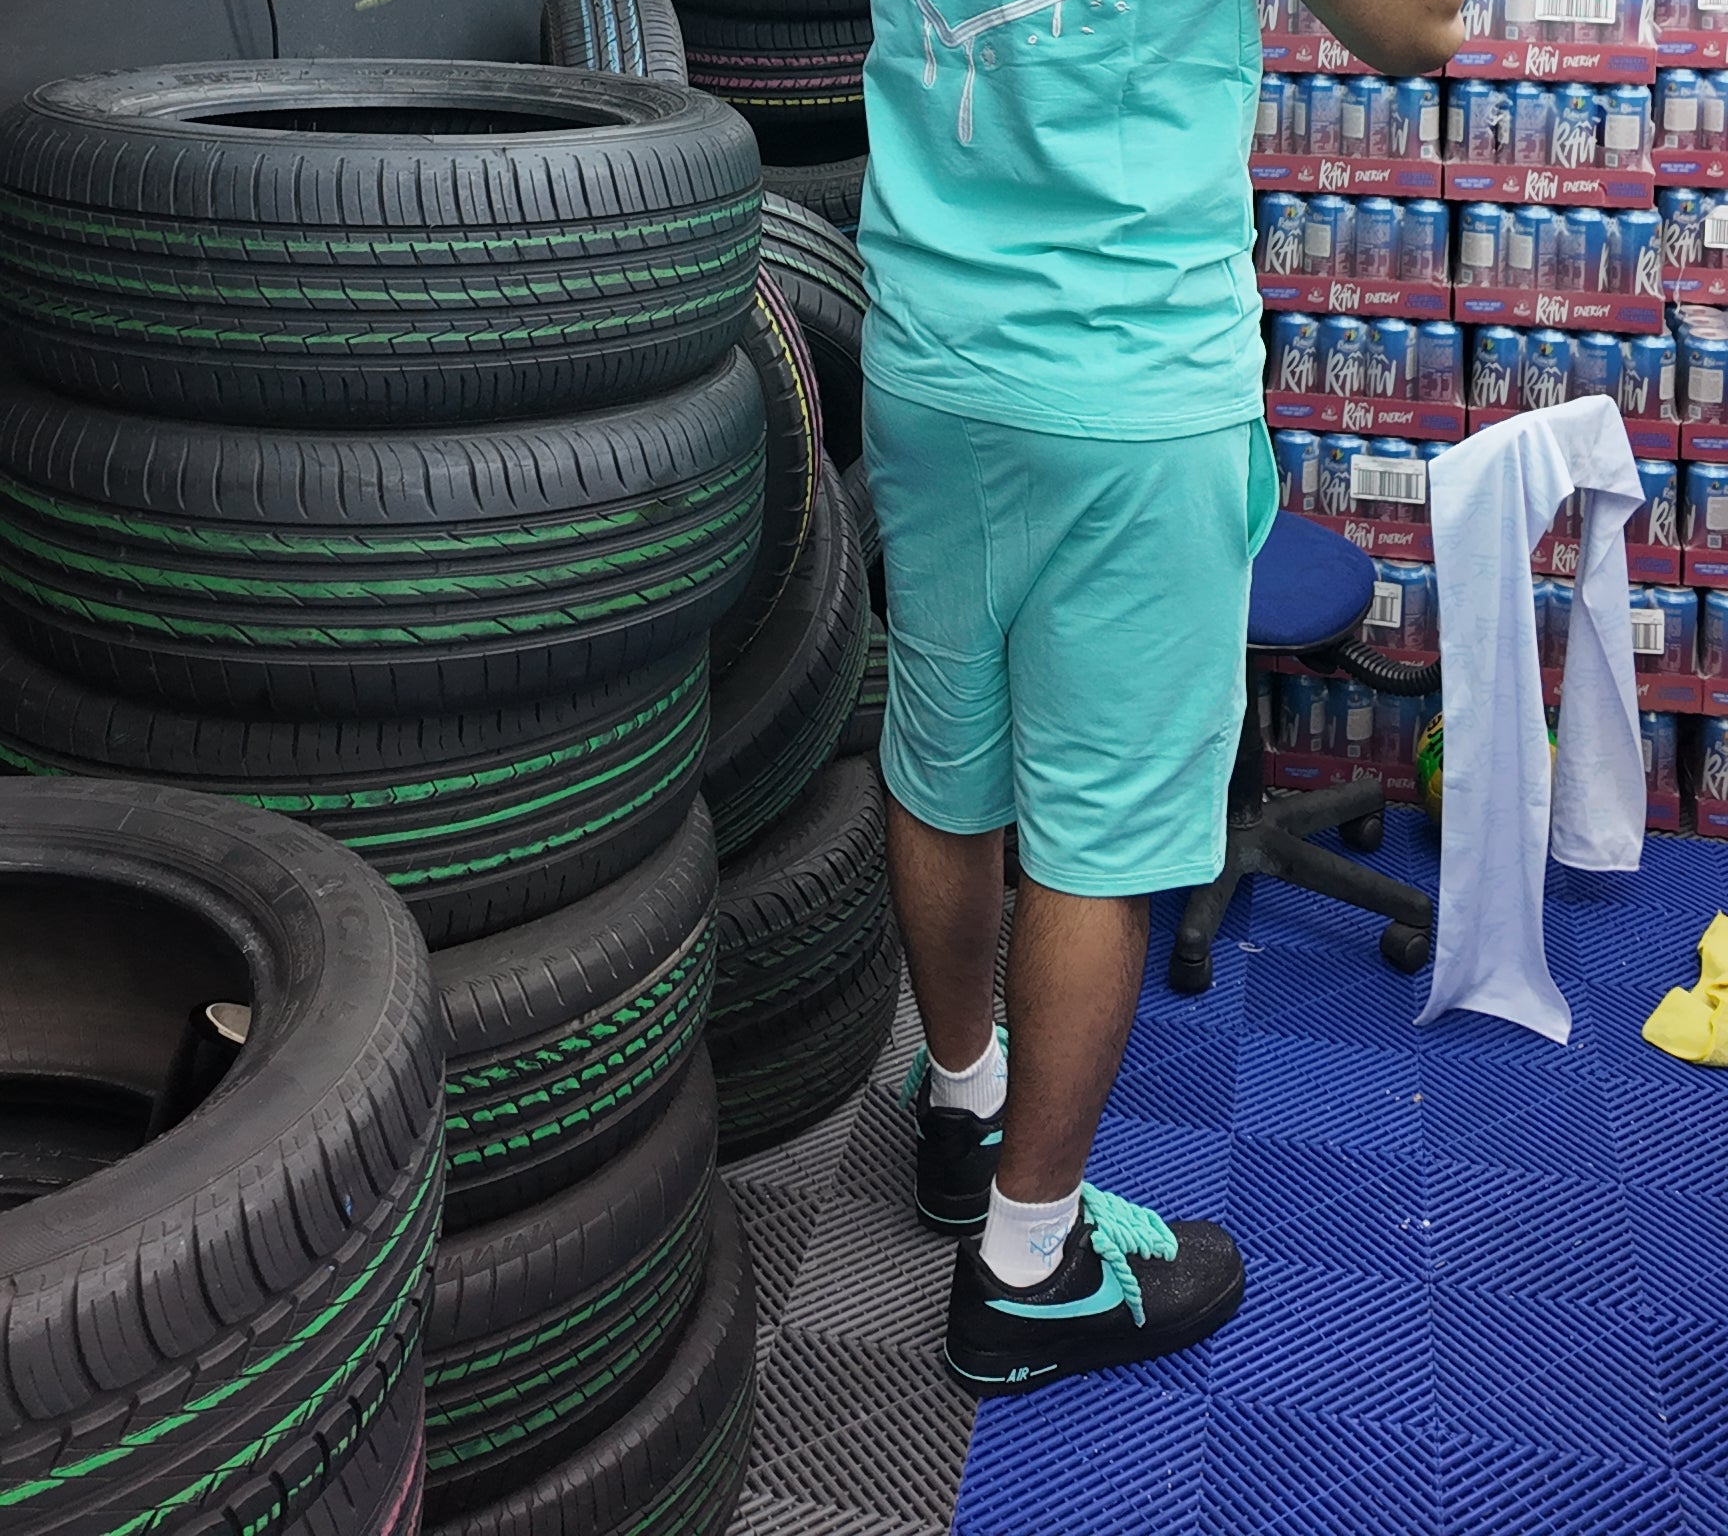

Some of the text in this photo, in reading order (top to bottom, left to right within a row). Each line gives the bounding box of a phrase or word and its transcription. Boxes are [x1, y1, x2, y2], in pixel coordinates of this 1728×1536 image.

[1525, 44, 1560, 77] RAW
[1562, 54, 1601, 69] ENERGY
[1551, 116, 1598, 169] RAW
[1318, 159, 1351, 192] RAW
[1354, 168, 1391, 183] ENERGY
[1524, 169, 1559, 202] RAW
[1562, 178, 1601, 193] ENERGY
[1328, 280, 1361, 313] RAW
[1364, 291, 1401, 304] ENERGY
[1535, 293, 1569, 326] RAW
[1573, 304, 1611, 318] ENERGY
[1366, 352, 1397, 398] AW
[1342, 399, 1375, 431] RAW
[1377, 411, 1414, 424] ENERGY
[1344, 519, 1414, 549] RAW ENERGY
[1006, 1367, 1030, 1383] AIR
